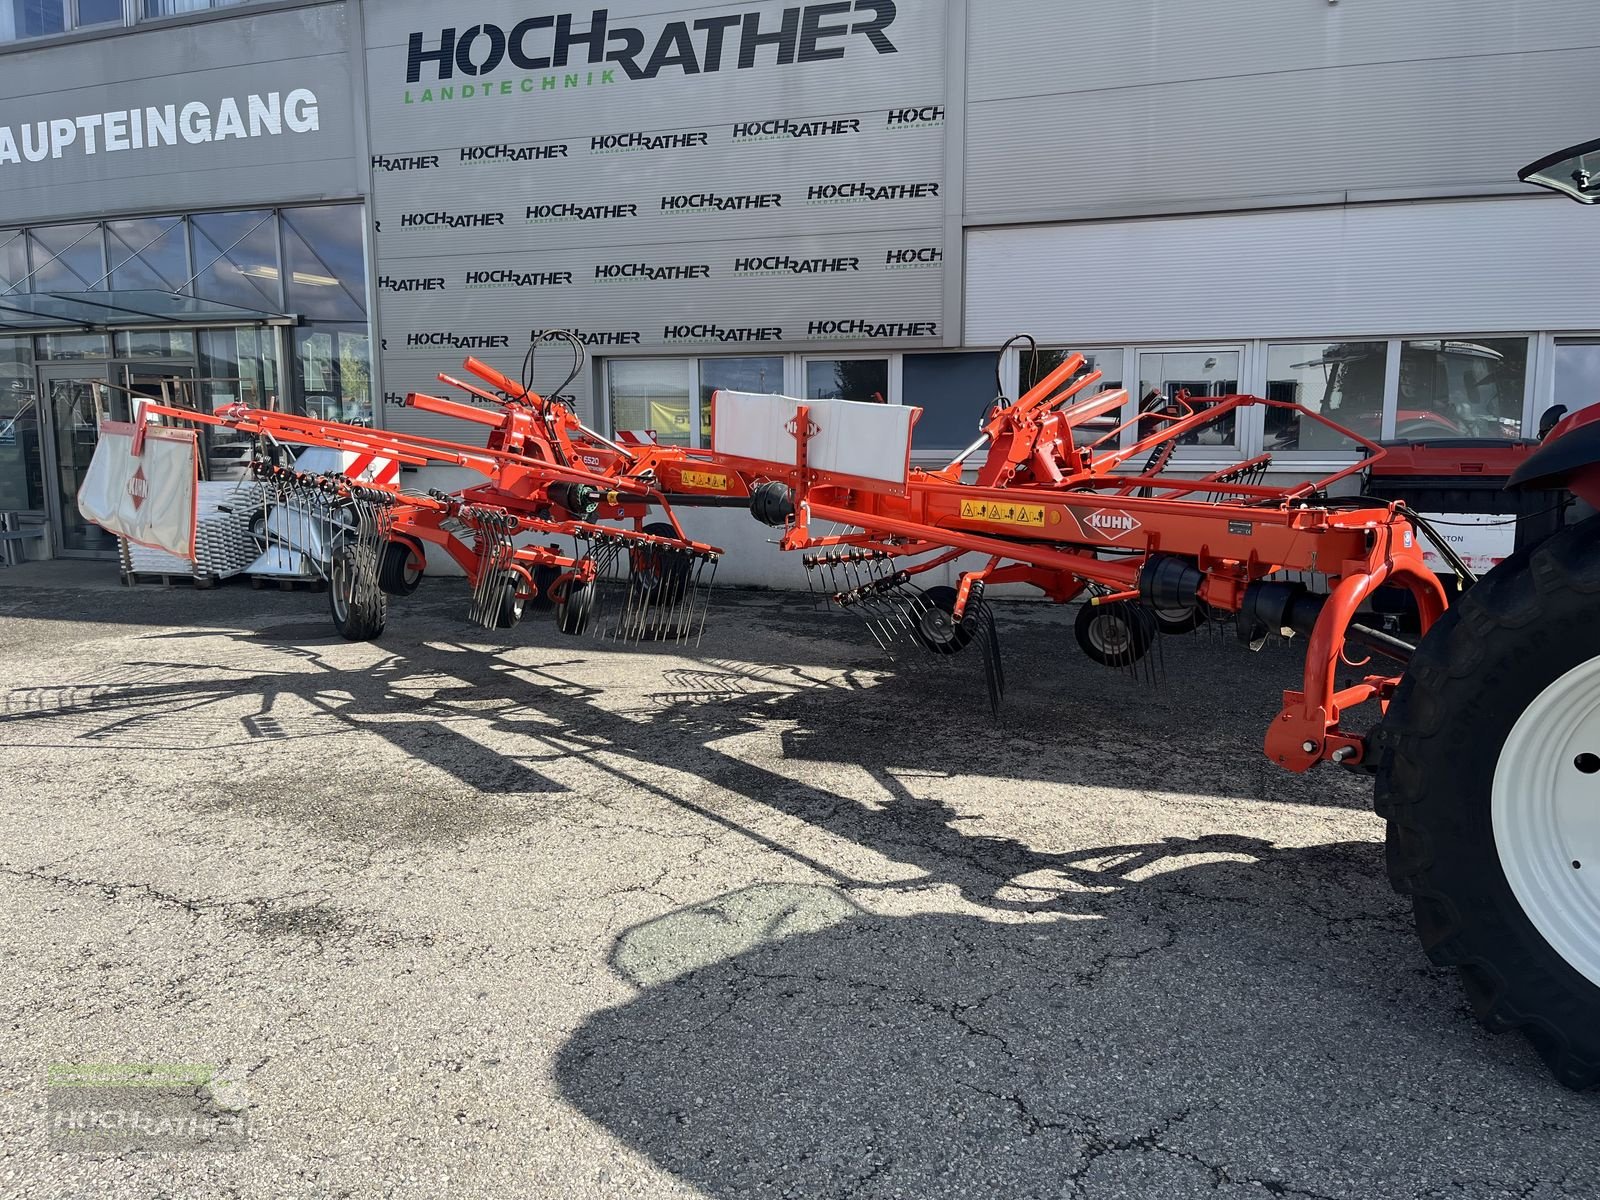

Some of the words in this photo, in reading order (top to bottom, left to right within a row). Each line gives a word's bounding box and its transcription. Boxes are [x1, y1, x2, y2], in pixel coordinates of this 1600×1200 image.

[406, 0, 898, 82] HOCHRATHER
[404, 68, 616, 104] LANDTECHNIK
[0, 88, 320, 165] AUPTEINGANG
[733, 119, 860, 137] HOCHRATHER
[590, 132, 709, 150] HOCHRATHER
[460, 144, 568, 161] HOCHRATHER
[807, 182, 939, 200] HOCHRATHER
[660, 193, 782, 210] HOCHRATHER
[401, 211, 504, 227] HOCHRATHER
[526, 203, 638, 220] HOCHRATHER
[594, 263, 711, 280] HOCHRATHER
[734, 255, 859, 273] HOCHRATHER
[465, 269, 573, 286] HOCHRATHER
[663, 324, 783, 341] HOCHRATHER
[807, 319, 937, 337] HOCHRATHER
[407, 332, 509, 348] HOCHRATHER
[583, 456, 600, 465] 6520
[1091, 514, 1134, 530] KUHN
